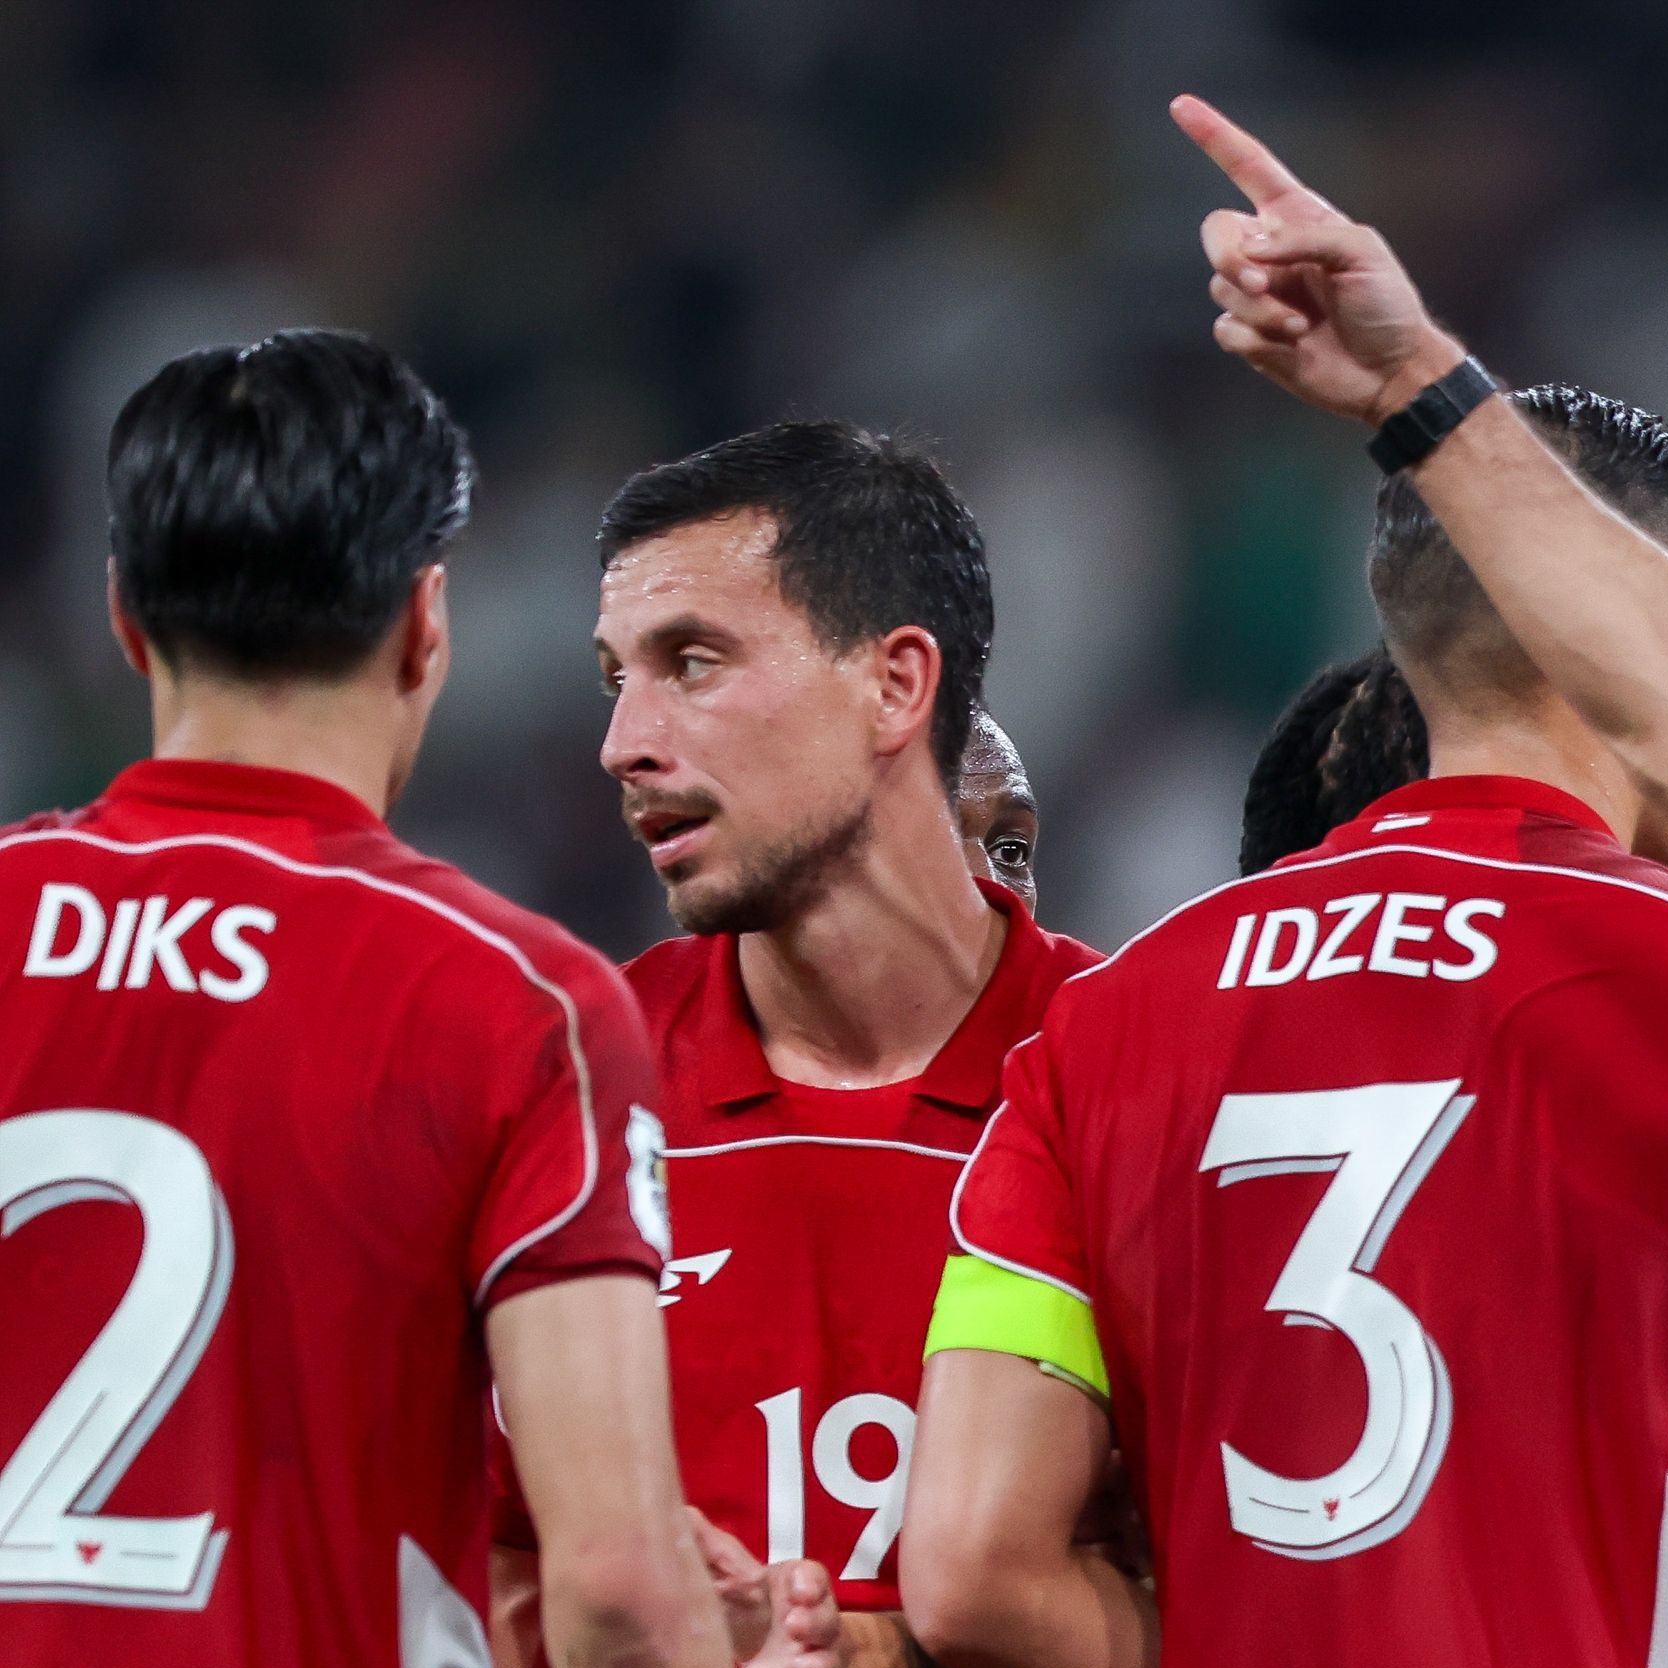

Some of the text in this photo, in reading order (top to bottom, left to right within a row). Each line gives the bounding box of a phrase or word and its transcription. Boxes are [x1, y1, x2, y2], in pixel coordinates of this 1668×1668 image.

[24, 883, 276, 1003] DIKS
[1218, 893, 1505, 990] IDZES
[0, 1107, 234, 1611] 2
[1199, 1078, 1477, 1561] 3
[754, 1386, 918, 1580] 19
